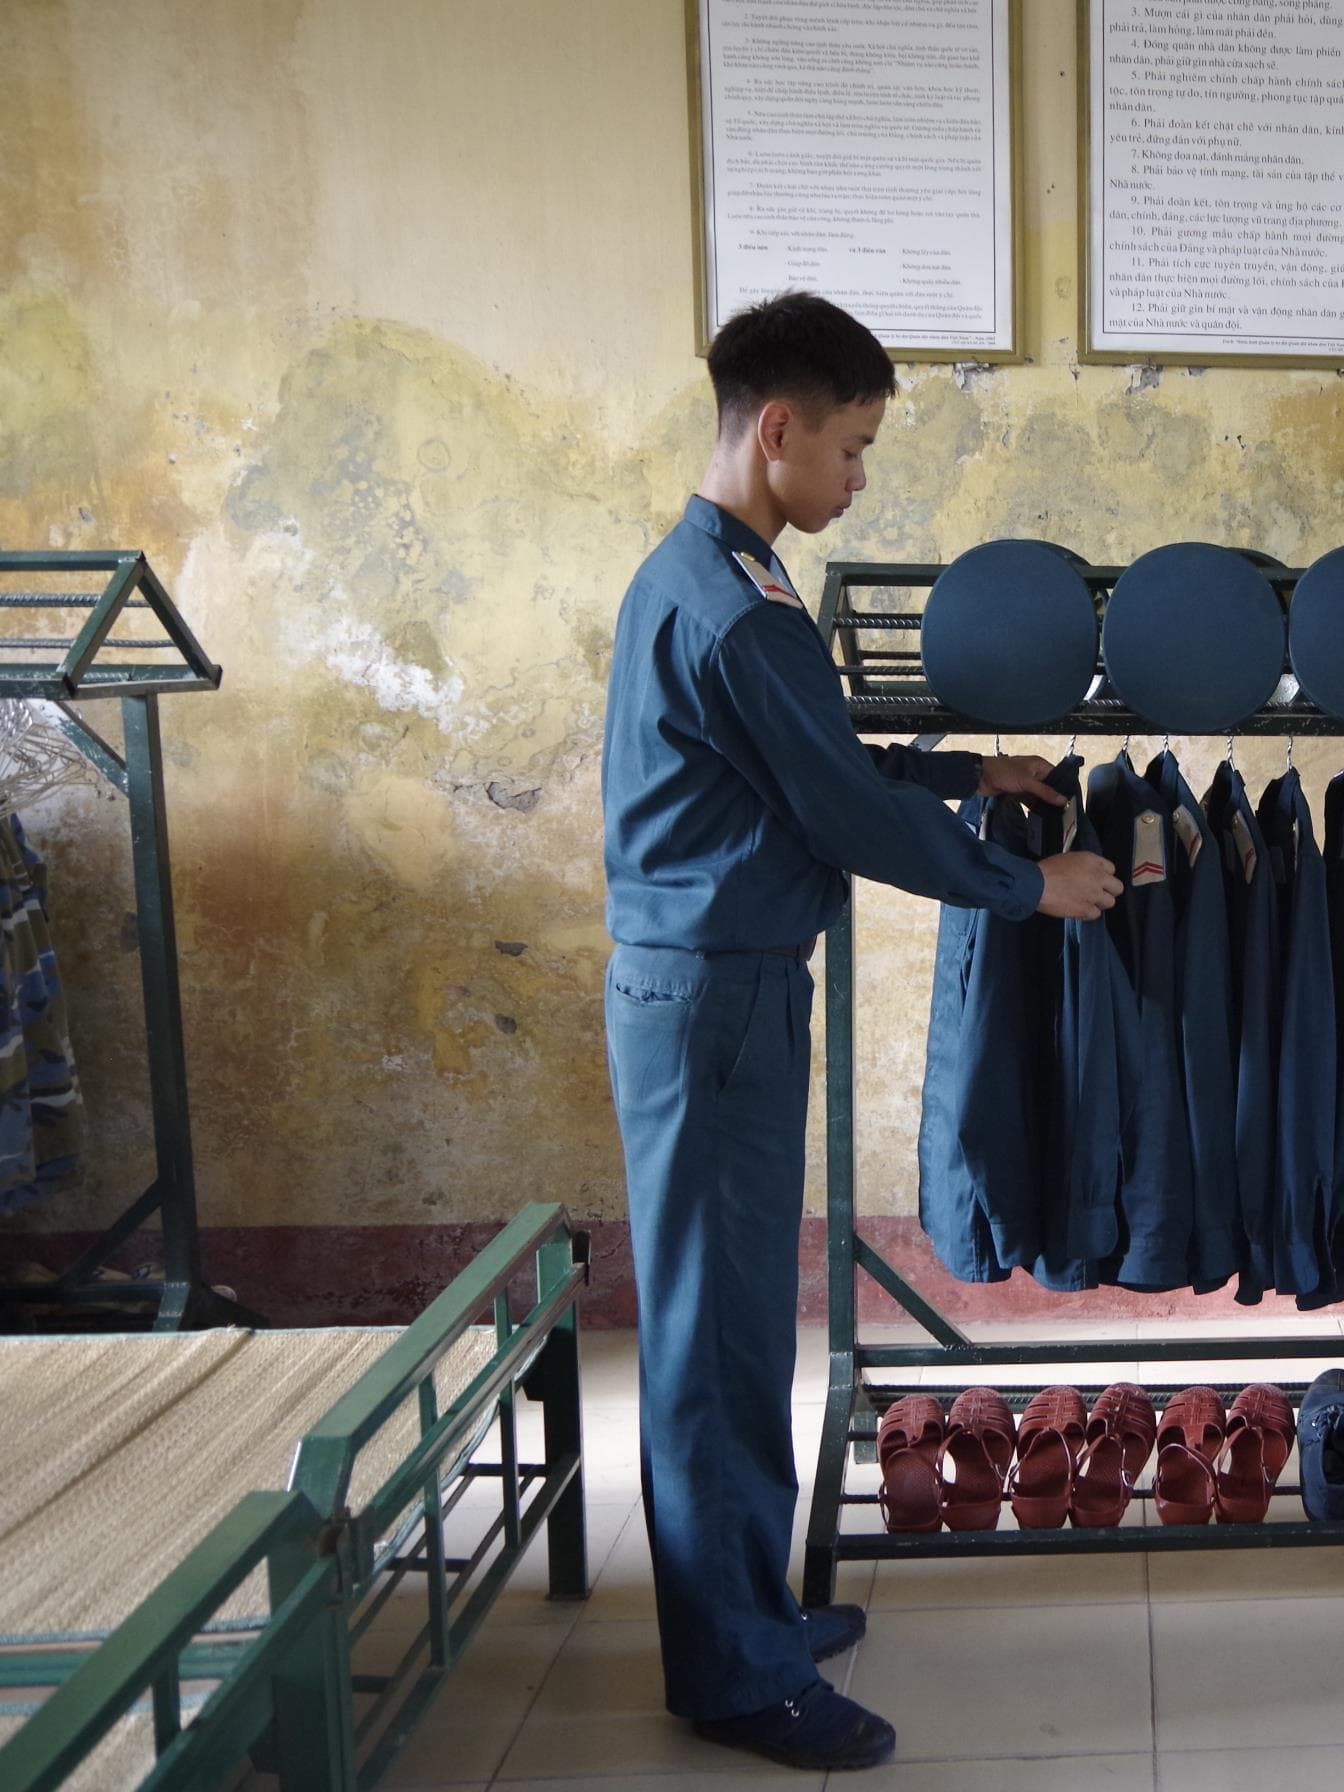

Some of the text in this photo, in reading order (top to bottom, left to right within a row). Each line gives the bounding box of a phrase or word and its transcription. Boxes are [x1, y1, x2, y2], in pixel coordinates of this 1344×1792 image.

[1130, 7, 1141, 16] 3.
[1130, 118, 1141, 127] 6.
[1132, 225, 1146, 235] 10.
[1131, 303, 1146, 312] 12.
